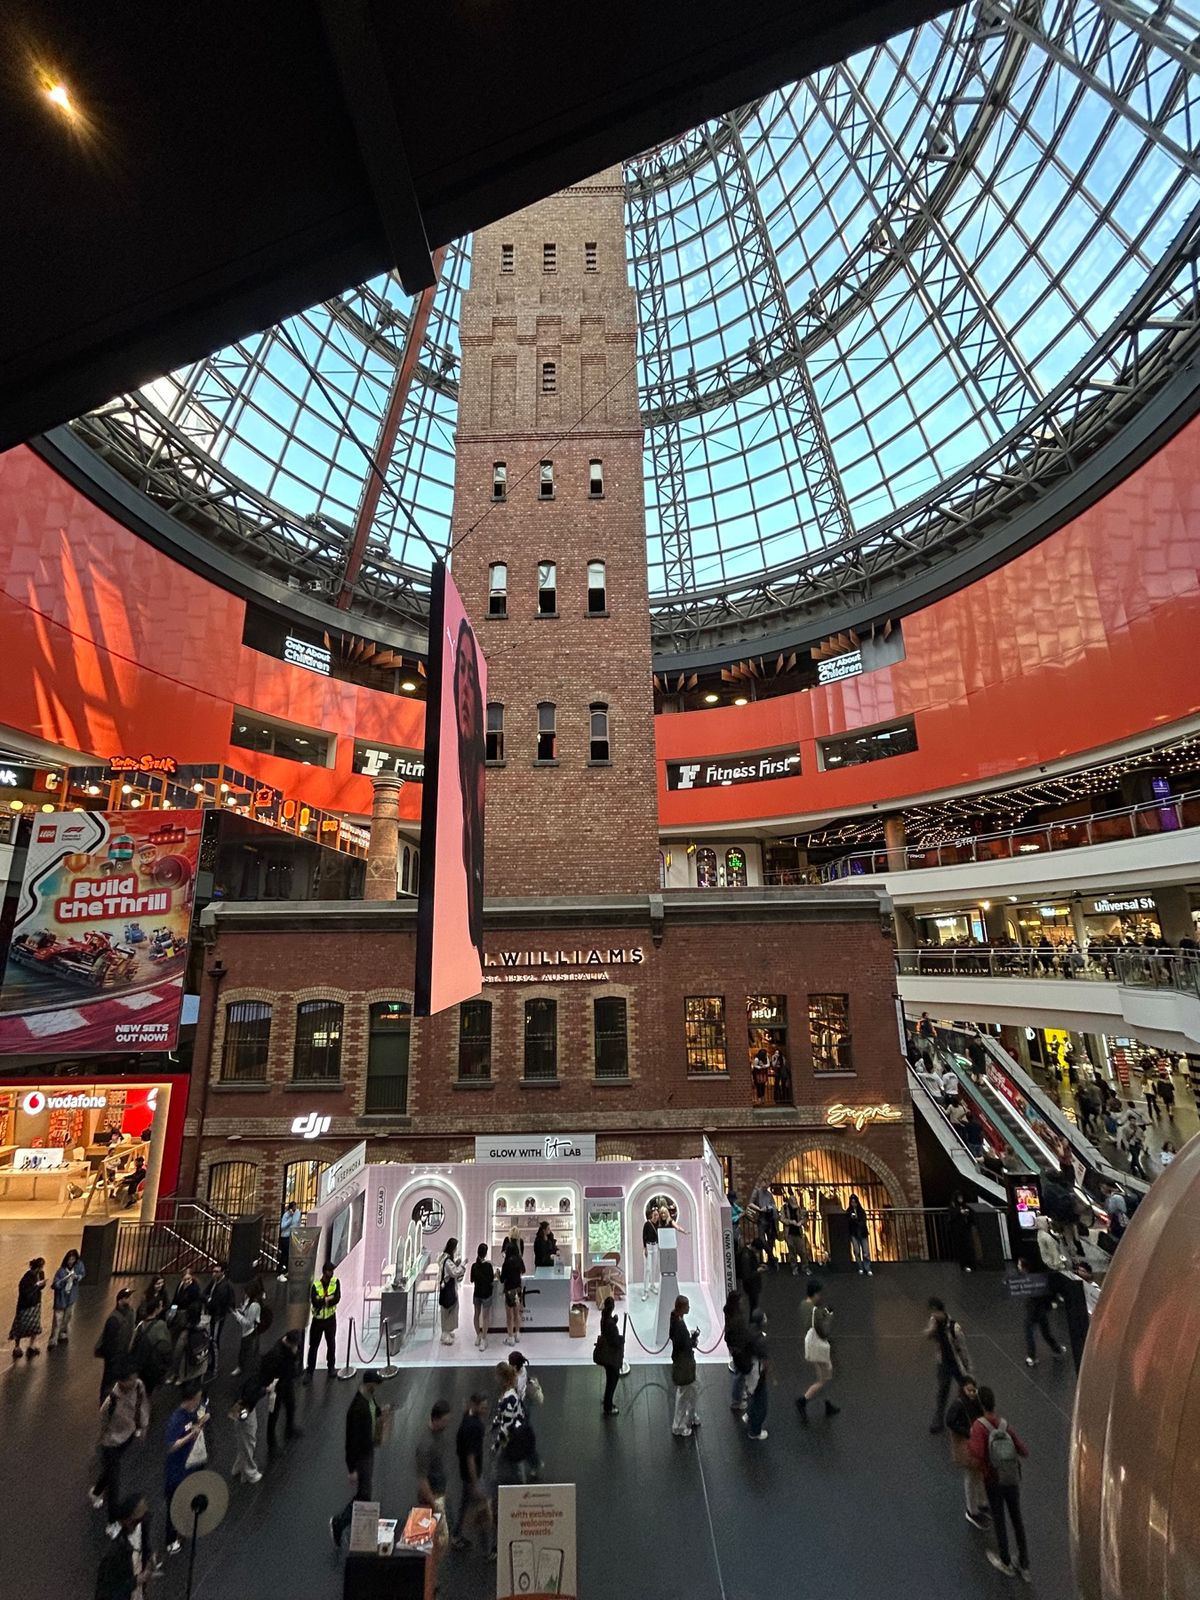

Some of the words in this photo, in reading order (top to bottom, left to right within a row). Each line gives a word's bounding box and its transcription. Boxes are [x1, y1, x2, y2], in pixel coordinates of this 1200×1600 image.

[285, 640, 305, 652] Only
[306, 647, 331, 662] About
[284, 648, 330, 672] Children
[818, 663, 835, 672] Only
[836, 653, 862, 667] About
[818, 662, 863, 681] Children
[706, 764, 756, 783] Fitness
[759, 758, 791, 777] First
[39, 830, 56, 838] LEGO
[74, 877, 134, 899] Build
[60, 900, 103, 919] the
[103, 893, 167, 915] Thrill
[1094, 898, 1139, 912] Universal
[115, 1024, 140, 1033] NEW
[142, 1023, 169, 1032] SETS
[115, 1033, 138, 1042] OUT
[138, 1033, 168, 1042] NOW!
[47, 1095, 107, 1109] vodafone
[489, 1149, 517, 1158] GLOW
[519, 1149, 542, 1157] WITH
[563, 1148, 582, 1157] LAB
[510, 1510, 528, 1519] with
[520, 1520, 554, 1528] welcome
